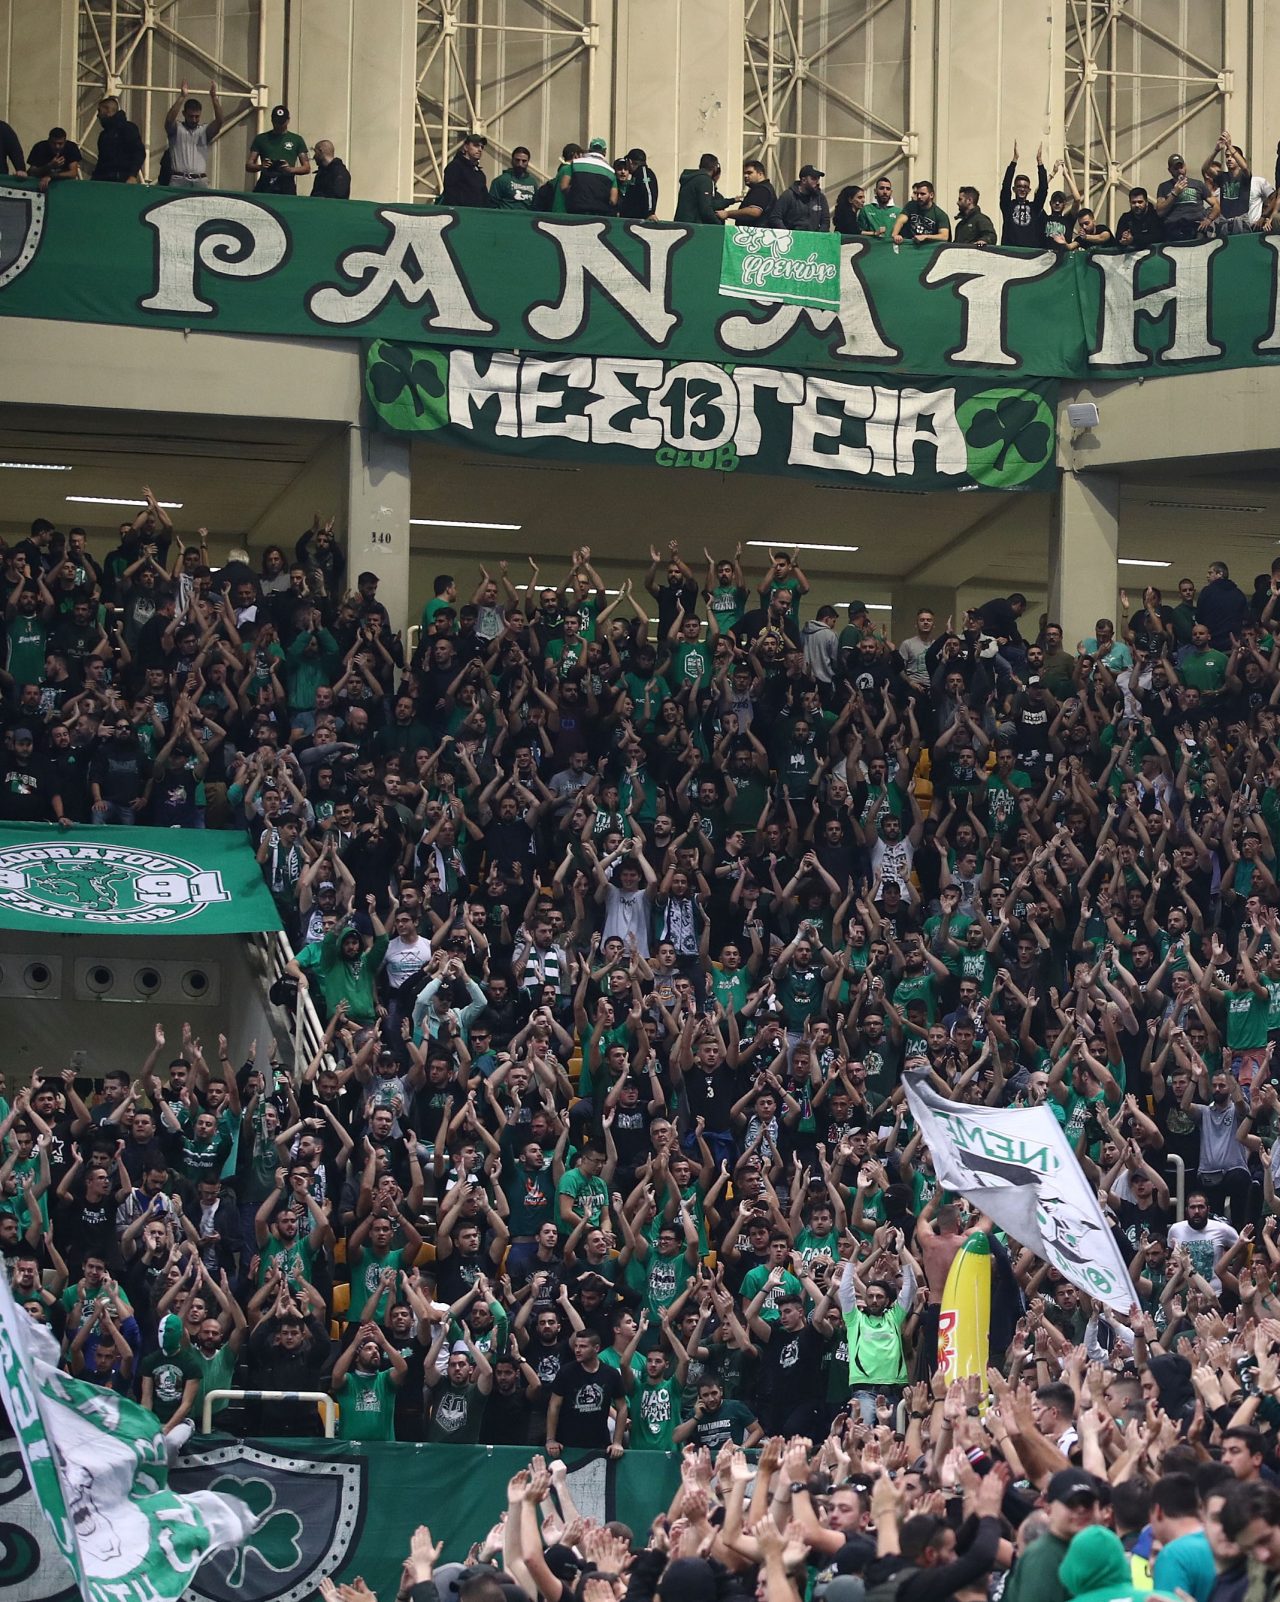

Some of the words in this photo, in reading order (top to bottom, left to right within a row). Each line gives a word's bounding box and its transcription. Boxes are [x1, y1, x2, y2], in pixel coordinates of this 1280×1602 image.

[655, 442, 740, 472] CLUB
[134, 872, 229, 905] 91
[84, 907, 178, 923] CLUB
